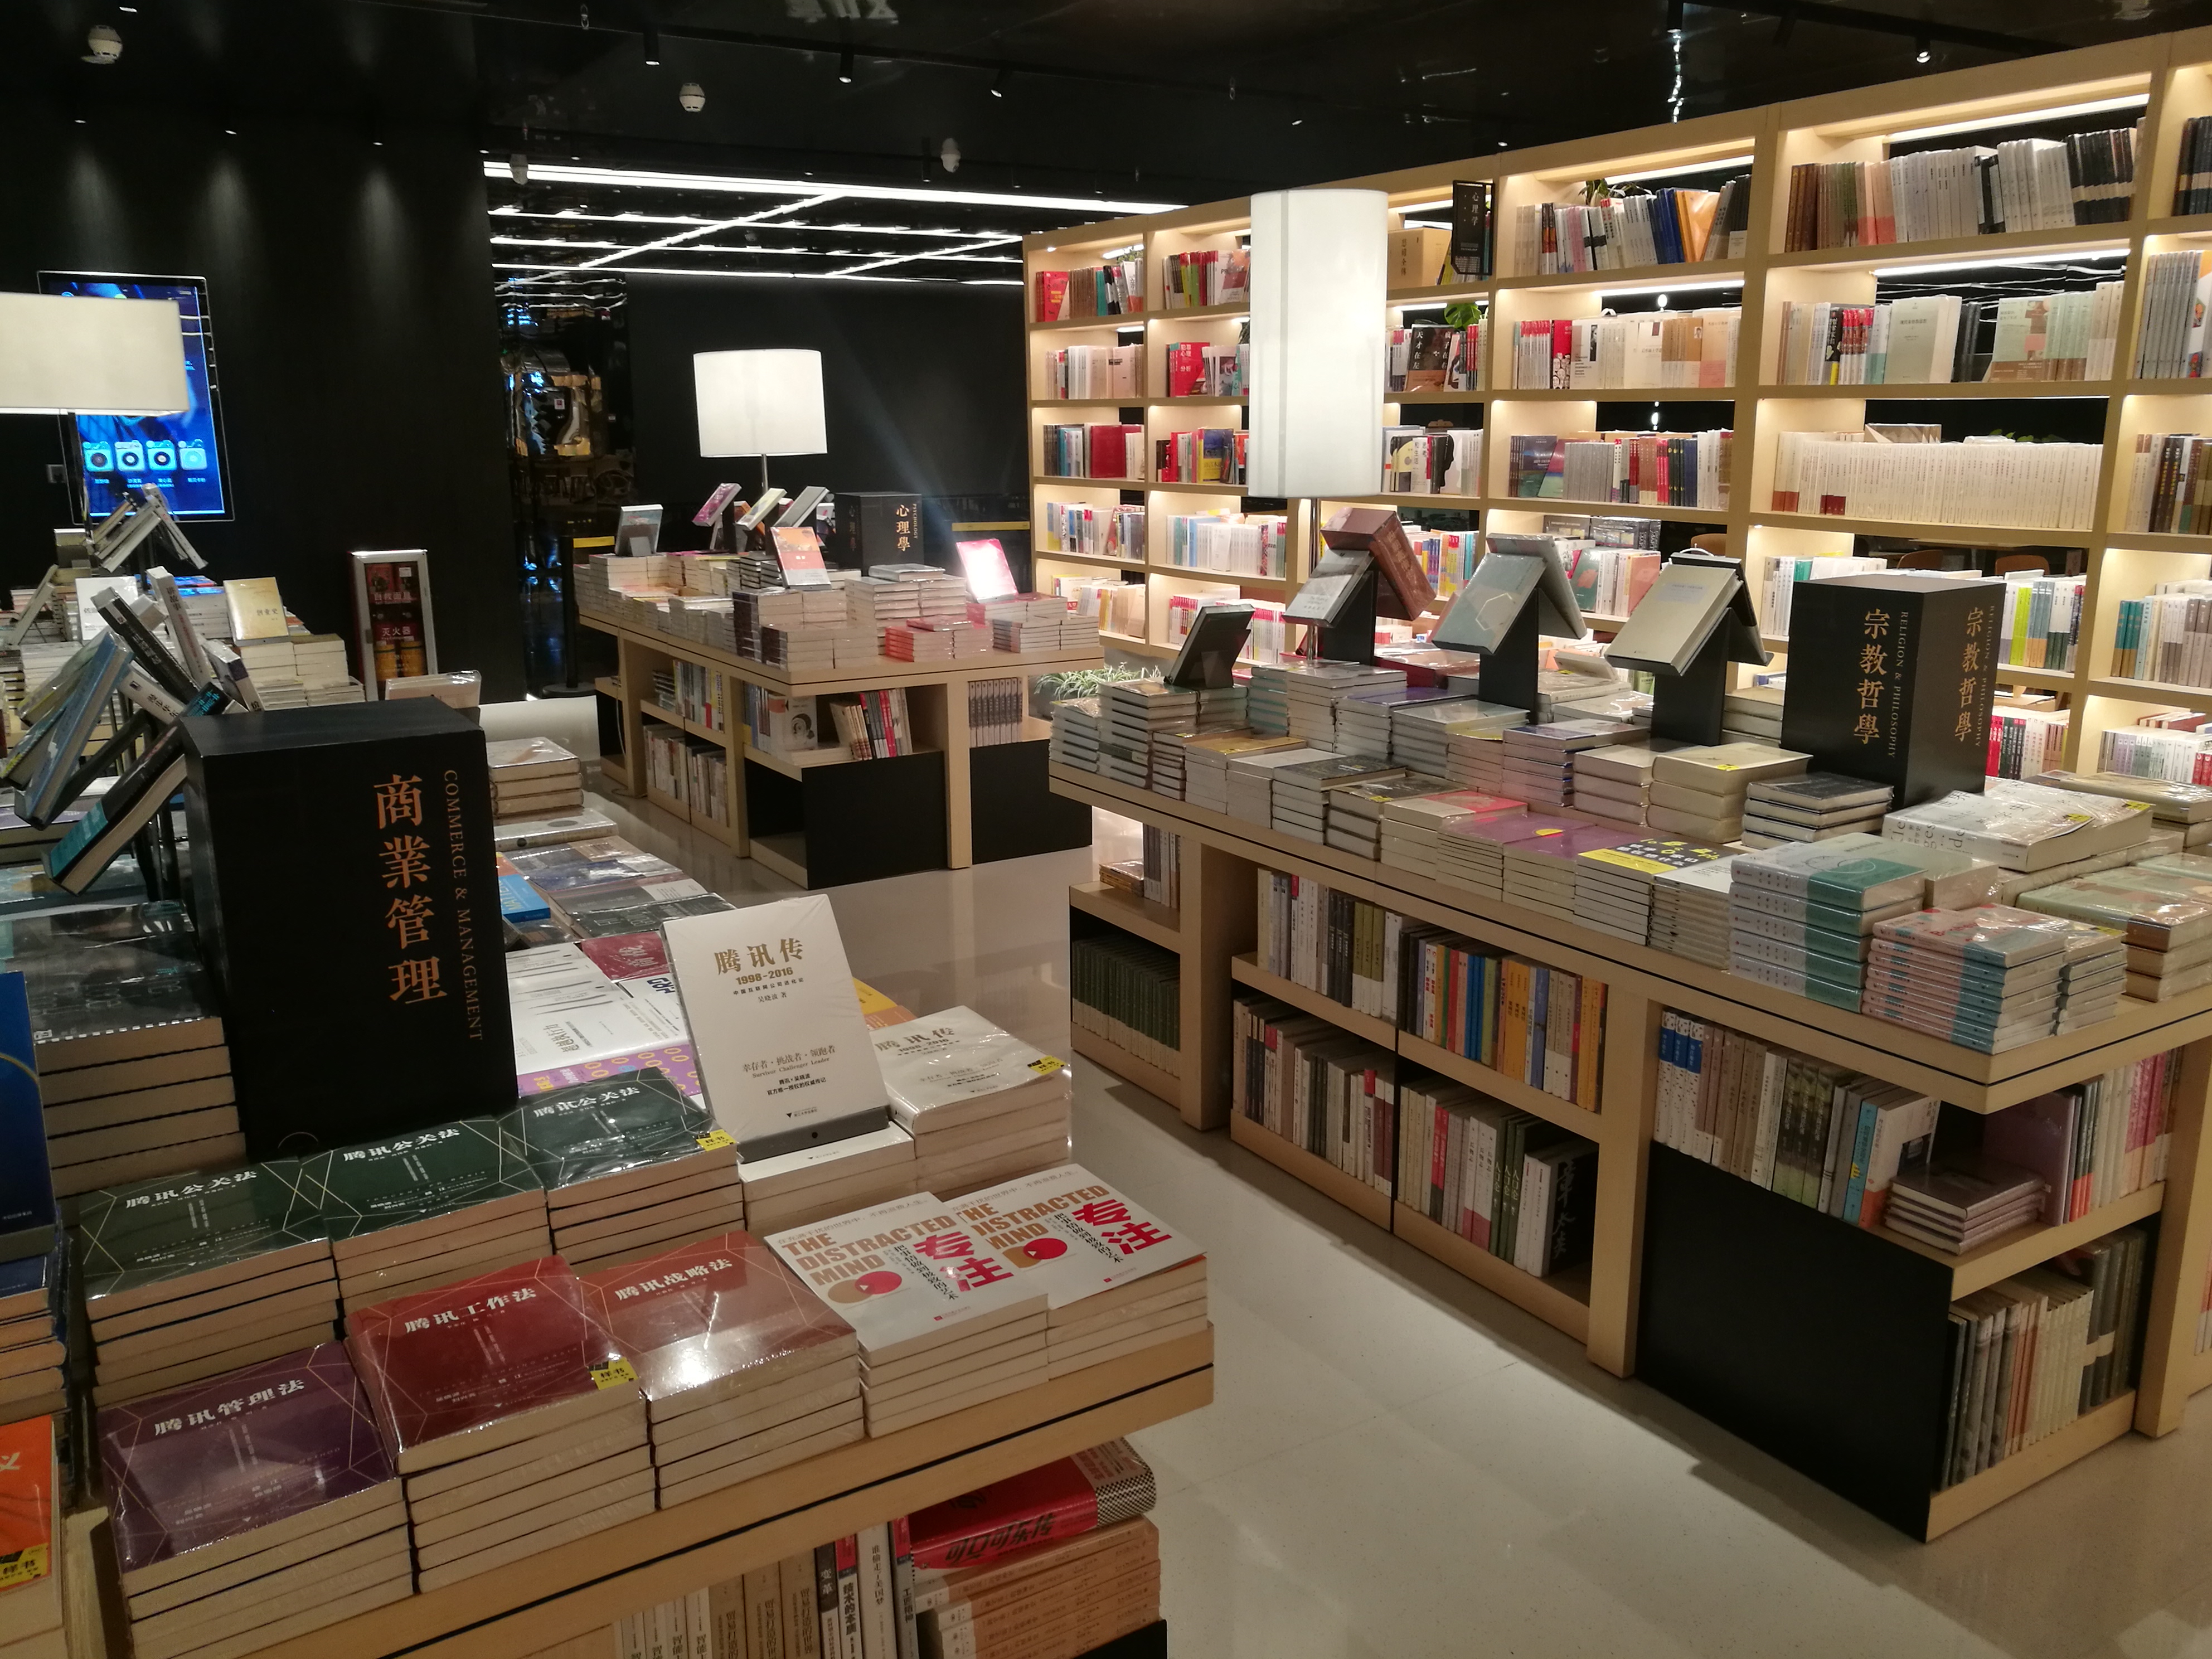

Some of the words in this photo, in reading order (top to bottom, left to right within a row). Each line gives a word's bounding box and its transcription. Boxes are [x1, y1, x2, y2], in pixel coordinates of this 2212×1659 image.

[1471, 192, 1479, 226] 心理学
[1413, 331, 1424, 369] 天才在左
[895, 504, 911, 552] 心理學
[374, 591, 412, 601] 自救面具
[382, 625, 411, 637] 灭火器
[1896, 611, 1909, 668] RELIGION
[1984, 605, 1995, 660] RELIGION
[1854, 608, 1890, 745] 宗教哲學
[1954, 607, 1984, 743] 宗教哲學
[1888, 686, 1901, 758] PHILOSOPHY
[1975, 677, 1987, 748] PHILOSOPHY
[444, 769, 467, 879] COMMERCE
[373, 774, 448, 1005] 商業管理
[455, 888, 468, 900] &
[457, 909, 483, 1040] MANAGEMENT
[714, 938, 804, 976] 腾讯传
[735, 967, 794, 986] 1998-2016
[733, 977, 804, 996] 中国互联网公司进化论
[758, 993, 779, 1003] 吴晓波
[874, 1026, 955, 1052] 腾讯传
[752, 1069, 777, 1079] Survivor
[778, 1062, 808, 1073] Challenger
[811, 1056, 830, 1065] Leader
[533, 1086, 641, 1118] 腾讯公关法
[343, 1128, 460, 1161] 腾讯公关法
[126, 1171, 257, 1209] 腾讯公关法
[1503, 1165, 1512, 1196] 人口论
[1511, 1169, 1520, 1201] 人口论
[781, 1231, 837, 1257] THE
[795, 1215, 957, 1272] DISTRACTED
[1071, 1199, 1173, 1255] 专注
[614, 1258, 733, 1302] 腾讯战略法
[809, 1254, 886, 1286] MIND
[913, 1230, 1014, 1293] 专注
[404, 1287, 537, 1334] 腾讯工作法
[154, 1379, 305, 1436] 腾讯管理法
[945, 1512, 1056, 1564] 可口可乐传
[820, 1568, 833, 1597] 变革
[871, 1544, 885, 1607] 谁偷走了美国梦
[842, 1582, 858, 1637] 技术的本质
